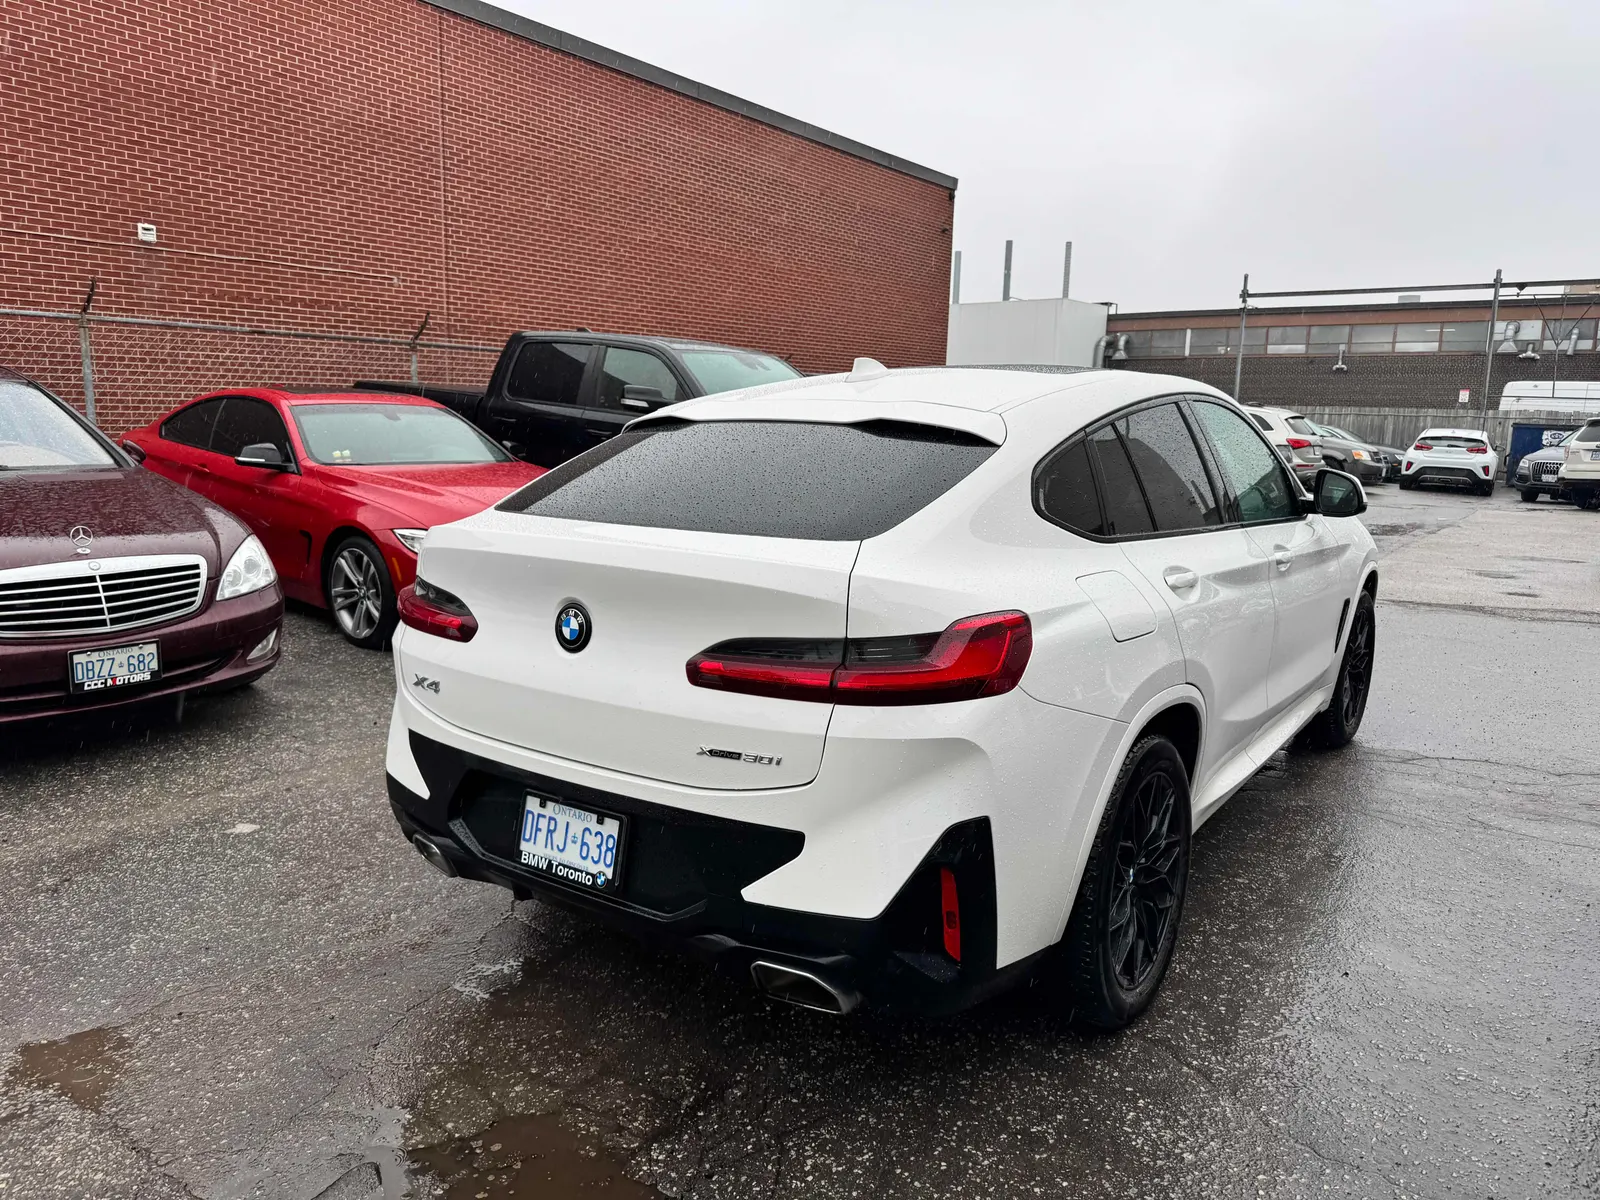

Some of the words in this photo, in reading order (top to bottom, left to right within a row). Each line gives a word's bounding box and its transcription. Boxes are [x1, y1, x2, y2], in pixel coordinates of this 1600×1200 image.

[98, 647, 133, 658] ONTARIO
[75, 657, 117, 682] DBZZ
[127, 652, 156, 673] 682
[84, 679, 105, 691] CCC
[107, 671, 151, 687] MOTORS
[413, 673, 440, 694] X4
[553, 803, 593, 823] ONTARIO
[522, 809, 570, 853] DFRJ
[579, 826, 616, 868] 638
[521, 851, 549, 870] BMW
[551, 860, 593, 886] Toronto
